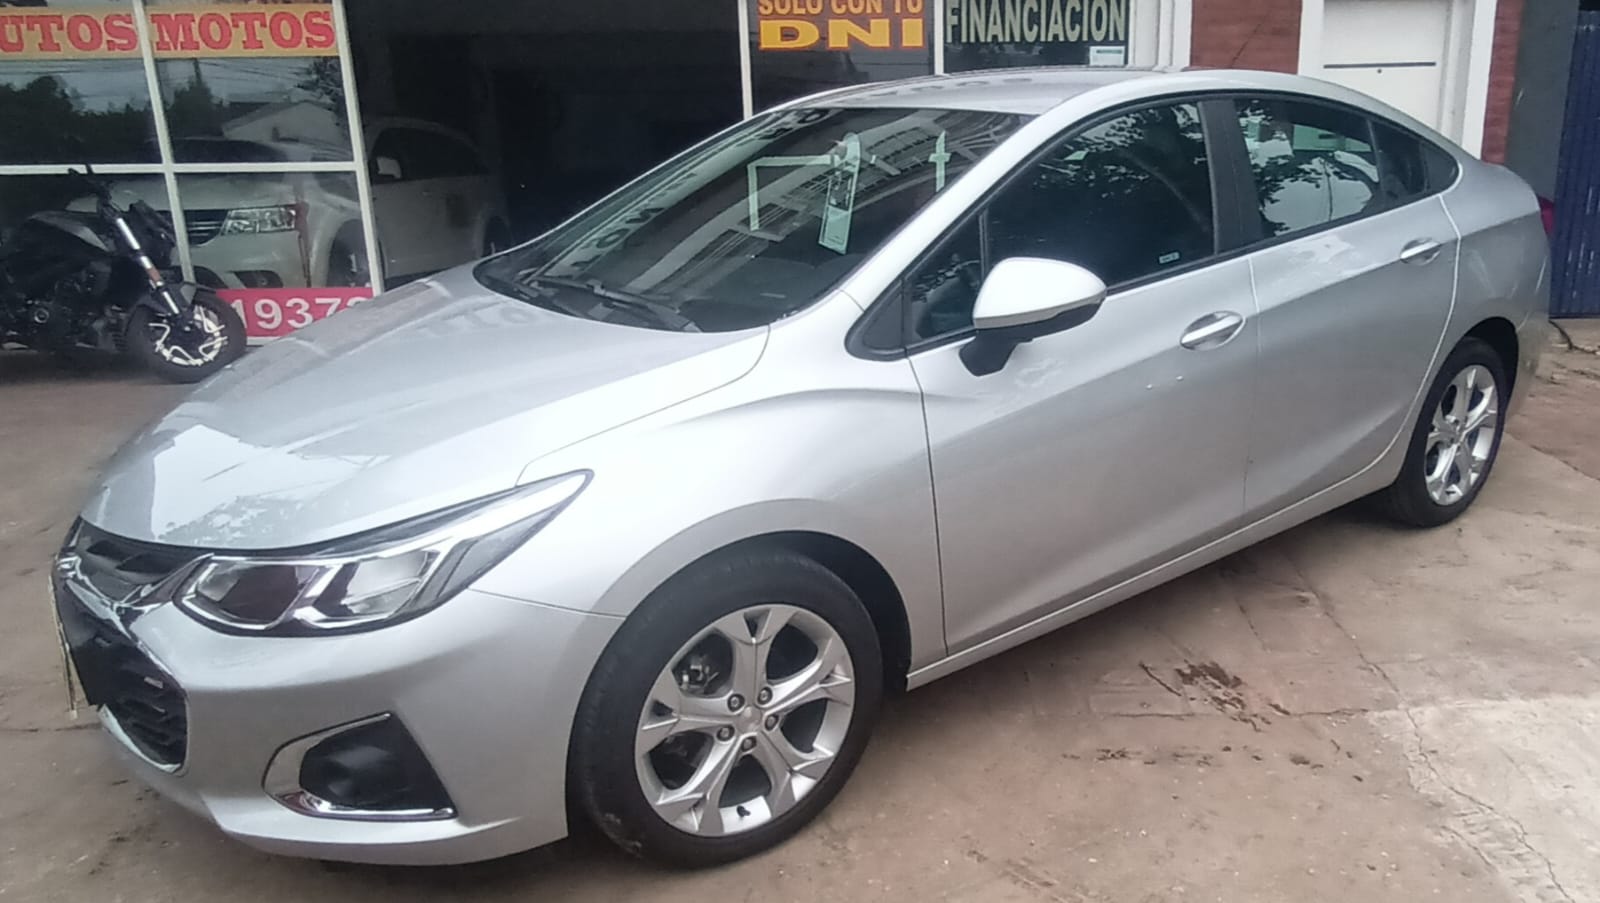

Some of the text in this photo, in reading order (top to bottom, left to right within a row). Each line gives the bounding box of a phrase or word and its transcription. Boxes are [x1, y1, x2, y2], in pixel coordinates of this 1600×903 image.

[758, 0, 822, 15] SOLO
[831, 0, 883, 14] CON
[946, 0, 1126, 43] FINANCIACION
[151, 11, 336, 51] MOTOS
[759, 18, 923, 49] DNI
[231, 296, 366, 330] 1937
